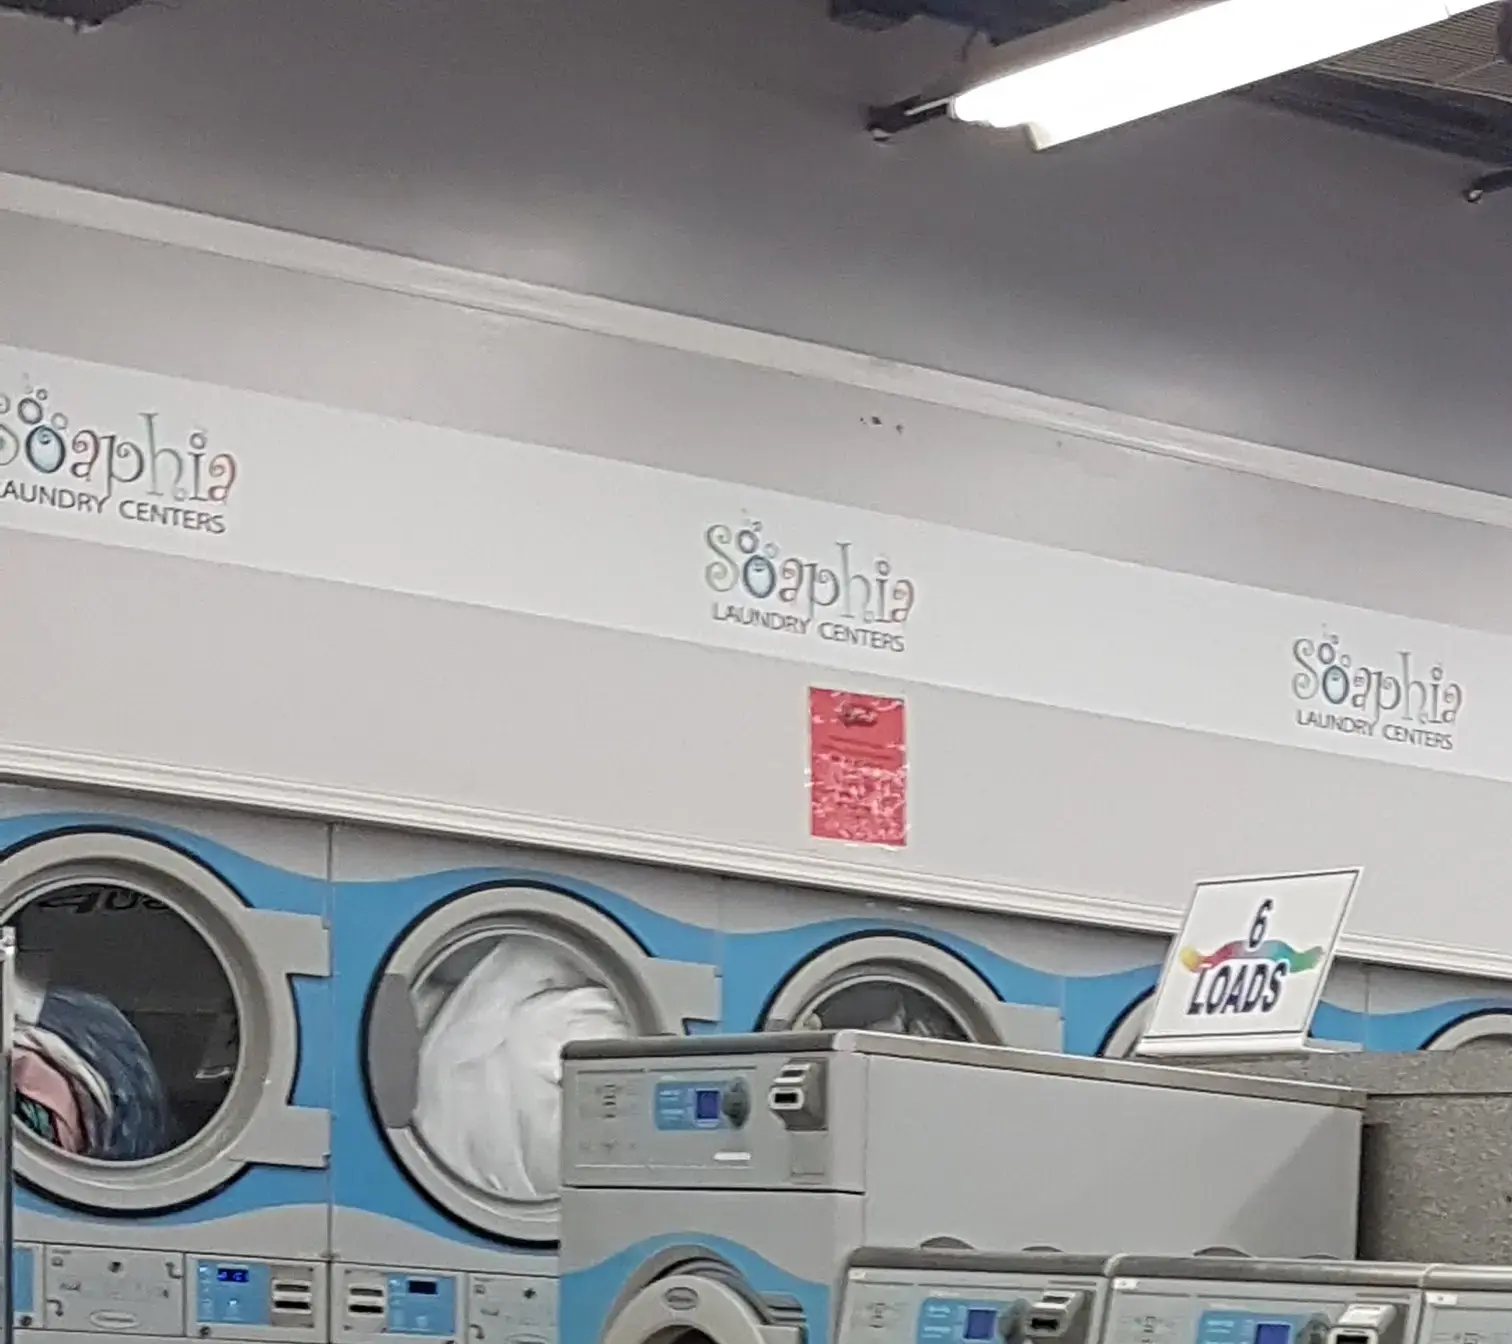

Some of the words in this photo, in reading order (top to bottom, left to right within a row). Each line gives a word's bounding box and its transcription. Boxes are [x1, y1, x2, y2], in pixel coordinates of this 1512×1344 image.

[0, 480, 110, 513] AUNDRY
[119, 500, 226, 534] CENTERS
[704, 524, 915, 623] Soaphia
[711, 601, 811, 634] LAUNDRY
[817, 621, 905, 652] CENTERS
[1292, 638, 1463, 725] Soaphia
[1297, 708, 1376, 737] LAUNDRY
[1382, 723, 1454, 750] CENTERS
[1249, 898, 1273, 948] 6
[1186, 961, 1287, 1016] LOADS
